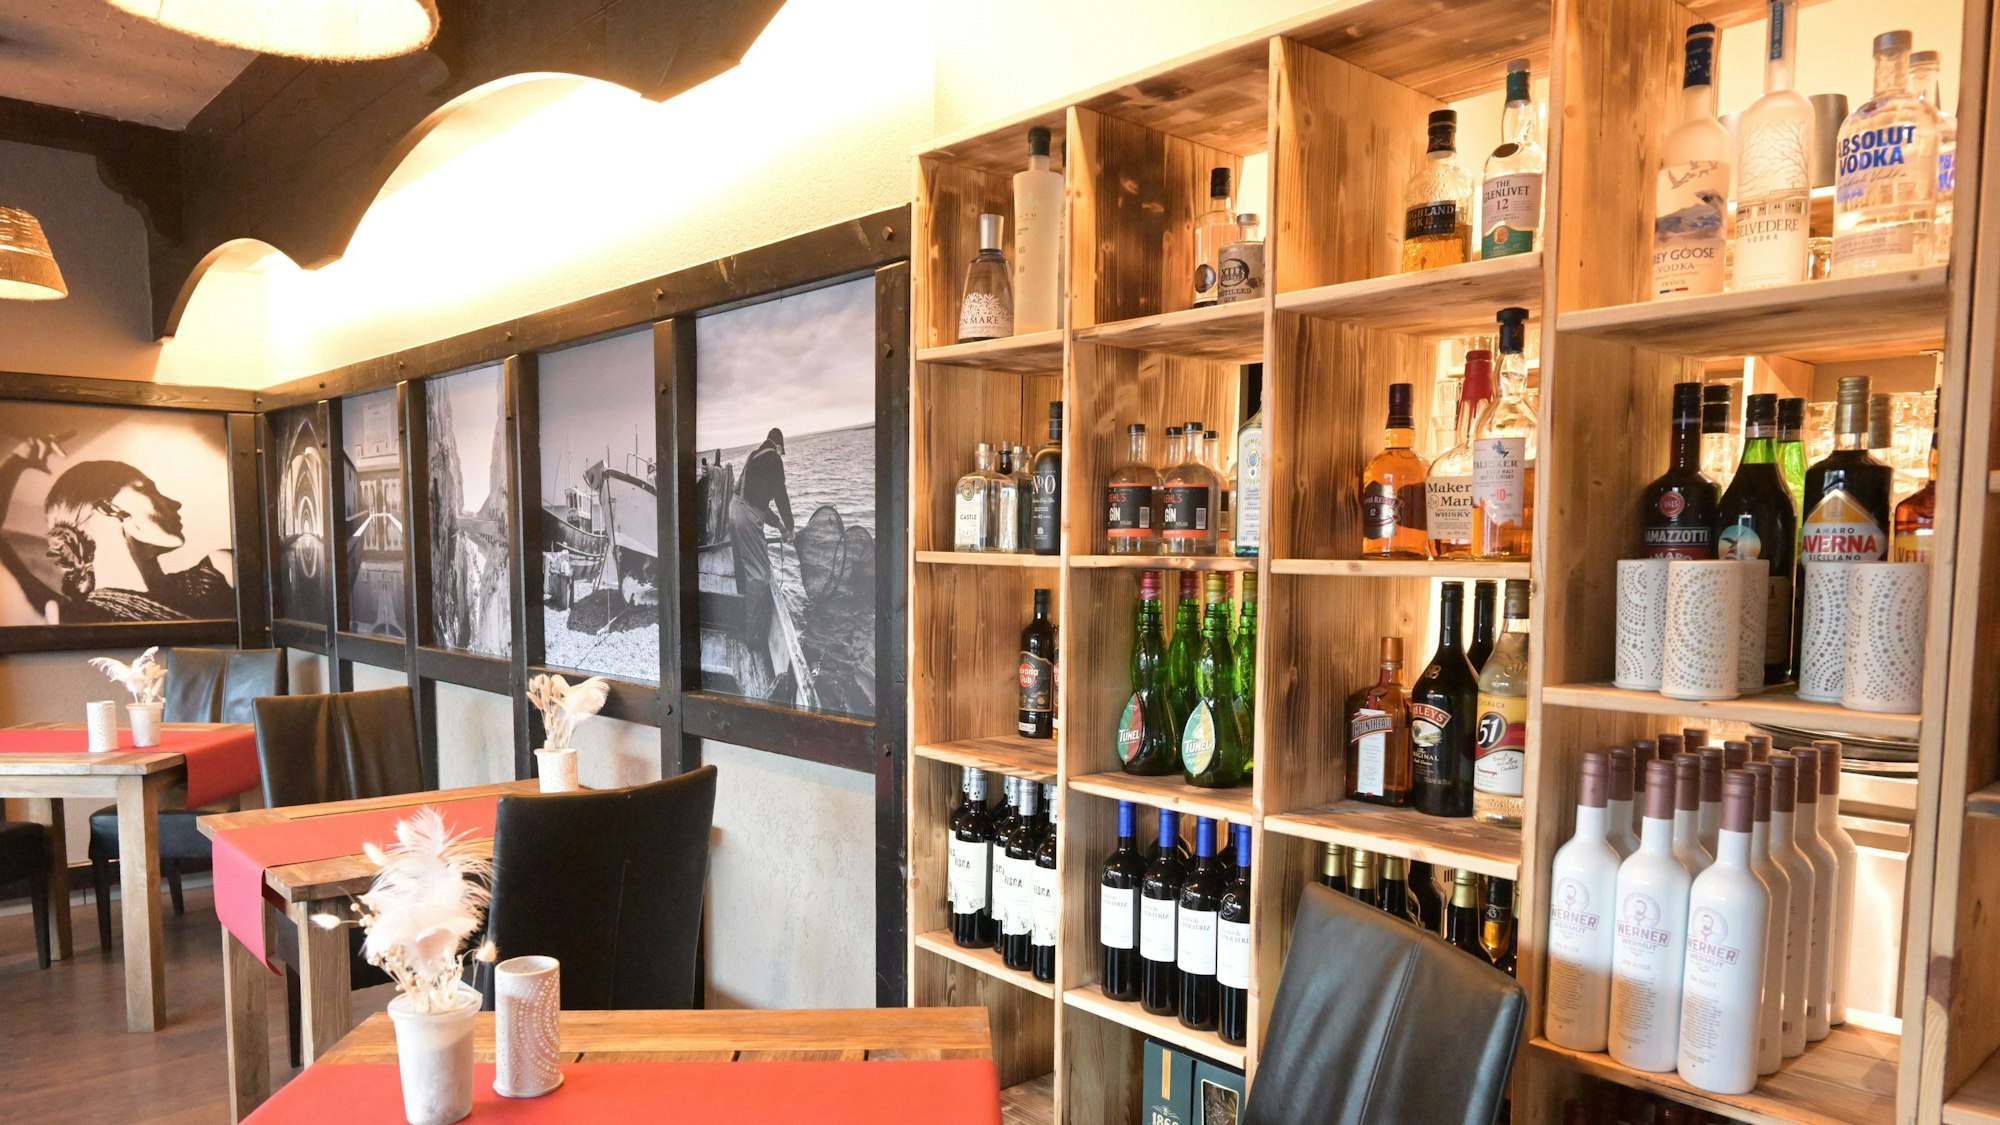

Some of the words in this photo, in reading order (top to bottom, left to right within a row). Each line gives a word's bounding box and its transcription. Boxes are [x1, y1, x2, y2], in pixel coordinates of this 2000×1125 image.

[1839, 146, 1905, 177] VODKA
[1496, 180, 1511, 188] THE
[1483, 186, 1530, 203] GLENLIVET
[1497, 198, 1509, 210] 12
[1736, 218, 1799, 238] BELVEDERE
[1670, 247, 1714, 260] GOOSE
[1658, 262, 1694, 273] VODKA
[970, 317, 1000, 325] MARE
[1427, 483, 1472, 493] Maker
[1802, 534, 1878, 554] AVERNA
[1478, 718, 1500, 745] 51
[1617, 923, 1669, 944] WERNER
[1622, 938, 1658, 951] WERMUT
